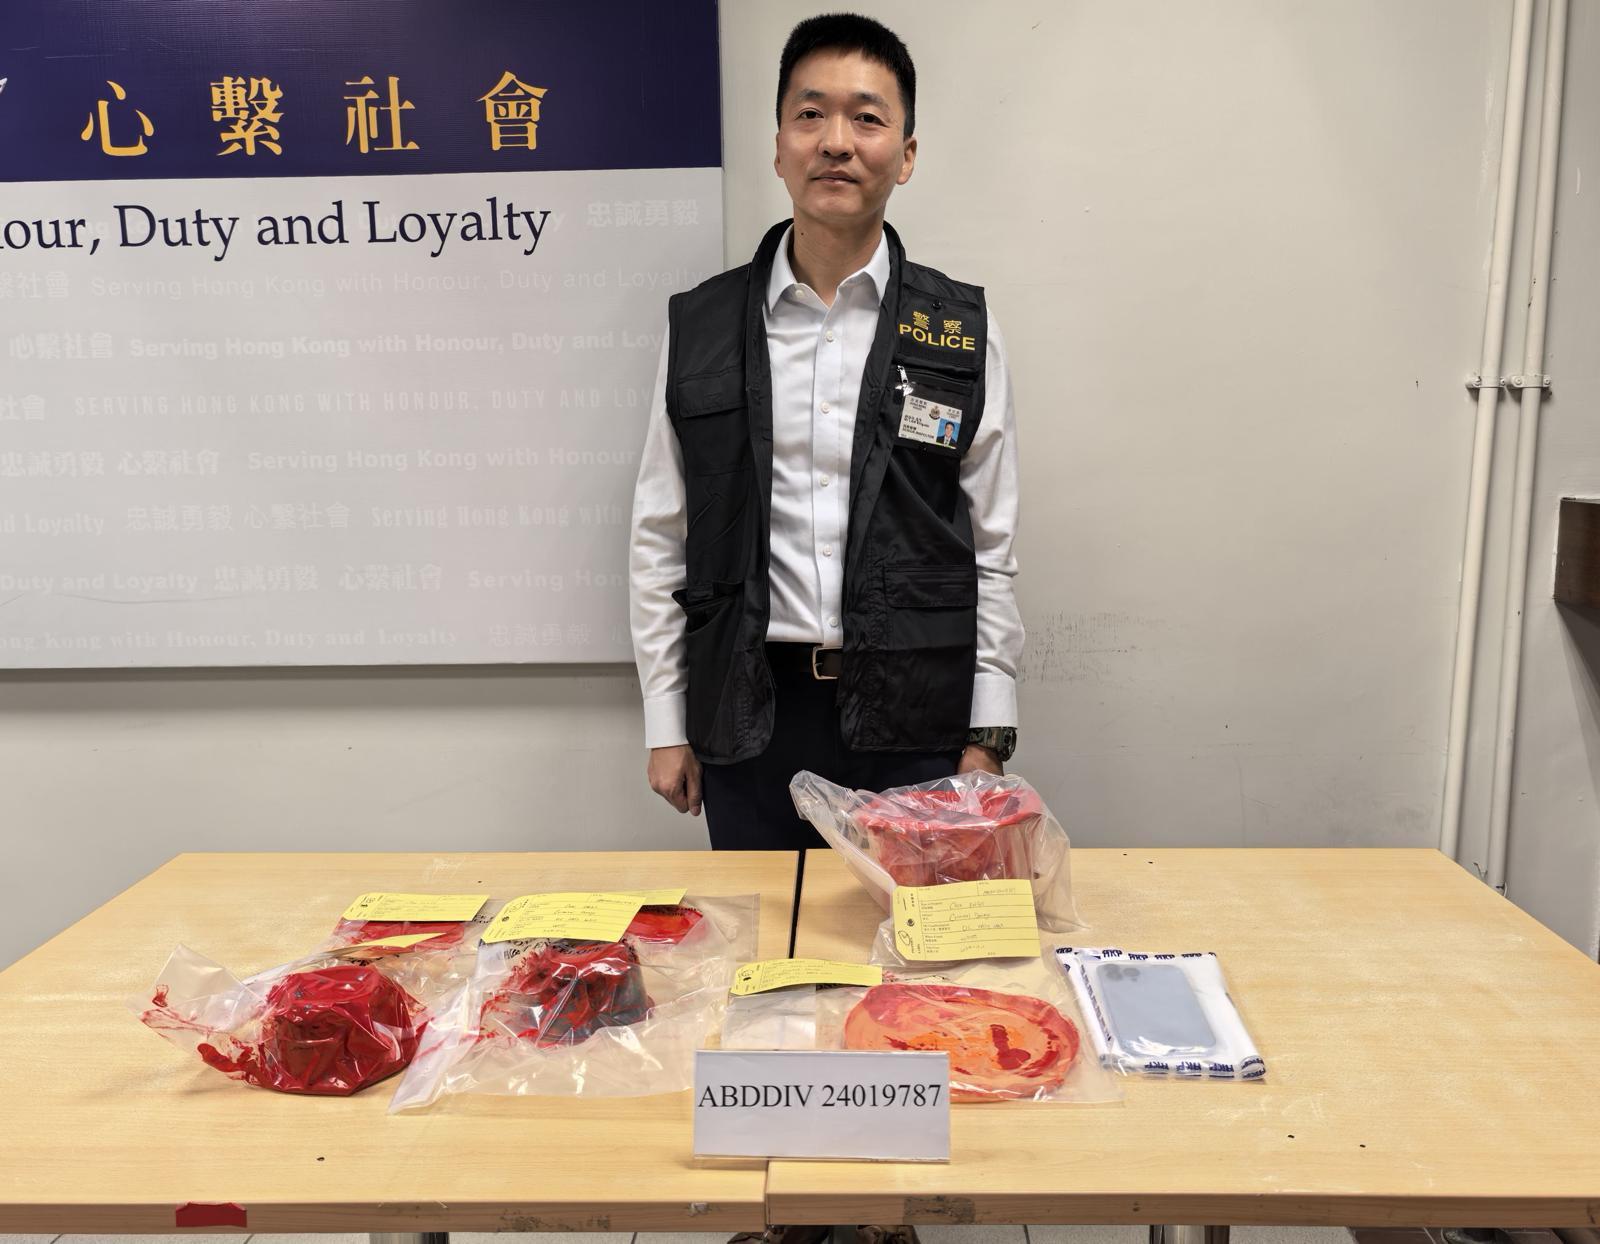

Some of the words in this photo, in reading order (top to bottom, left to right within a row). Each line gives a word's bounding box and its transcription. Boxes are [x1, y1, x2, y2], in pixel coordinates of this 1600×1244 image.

[81, 71, 548, 158] 心繫社會
[585, 200, 700, 228] 忠誠勇毅
[113, 203, 240, 263] Duty
[256, 200, 349, 246] and
[361, 196, 552, 259] Loyalty
[90, 276, 183, 300] Serving
[192, 275, 255, 299] Hong
[265, 274, 326, 297] Kong
[336, 272, 382, 292] with
[500, 269, 552, 294] Duty
[562, 269, 607, 289] and
[912, 311, 962, 334] 警察
[128, 338, 218, 360] Serving
[225, 336, 285, 358] Hong
[291, 336, 351, 357] Kong
[358, 334, 407, 354] with
[512, 330, 564, 354] Duty
[572, 330, 614, 350] and
[899, 323, 976, 351] POLICE
[74, 395, 169, 417] SERVING
[181, 394, 239, 415] HONG
[250, 393, 305, 414] KONG
[318, 391, 370, 412] WITH
[491, 388, 546, 410] DUTY
[559, 388, 601, 409] AND
[248, 450, 338, 473] Serving
[347, 449, 408, 472] Hong
[416, 448, 477, 470] Kong
[486, 447, 539, 467] with
[24, 511, 105, 537] Loyalty
[370, 505, 449, 529] Serving
[518, 503, 570, 527] Kong
[1, 573, 54, 596] Duty
[62, 572, 105, 592] and
[113, 570, 199, 595] Loyalty
[467, 568, 564, 592] Serving
[45, 631, 102, 652] Kong
[112, 631, 158, 649] with
[265, 629, 315, 650] Duty
[326, 629, 366, 648] and
[698, 1084, 814, 1108] ABDDIV
[821, 1084, 942, 1108] 24019787
